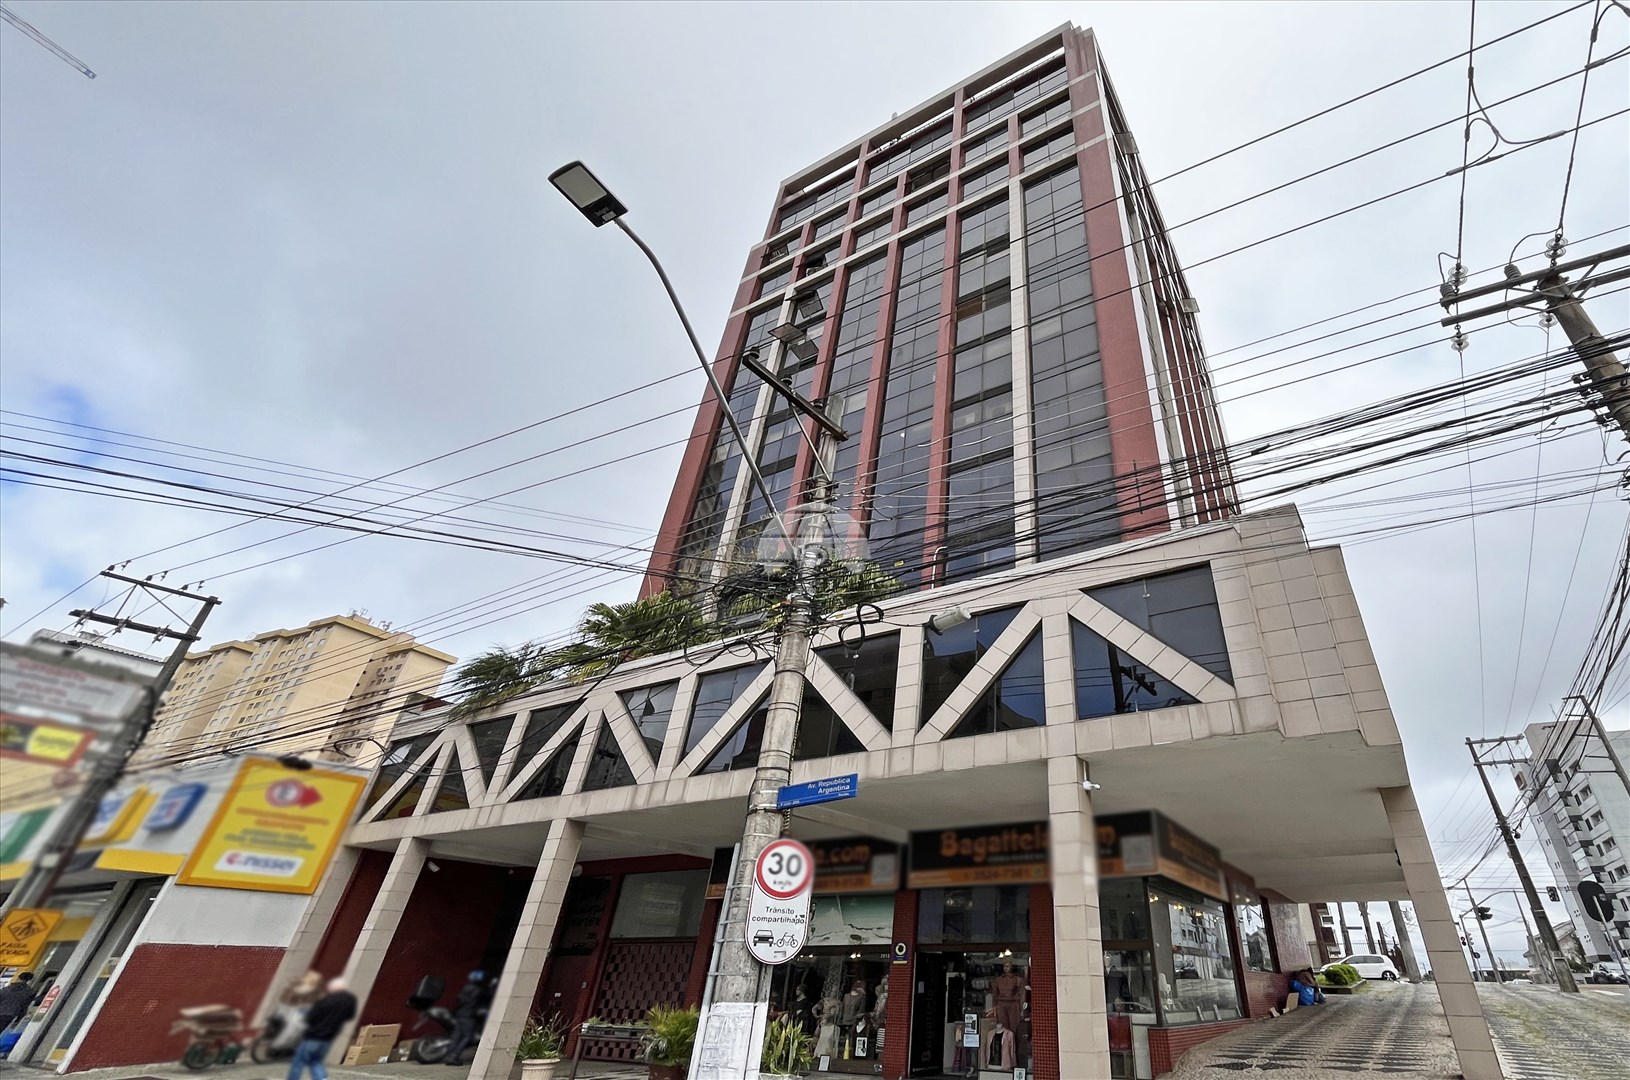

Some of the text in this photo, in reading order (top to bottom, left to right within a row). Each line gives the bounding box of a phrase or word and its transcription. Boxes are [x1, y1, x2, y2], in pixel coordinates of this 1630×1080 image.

[818, 784, 850, 794] Argentina
[768, 852, 803, 877] 30
[765, 906, 795, 914] Trânsito
